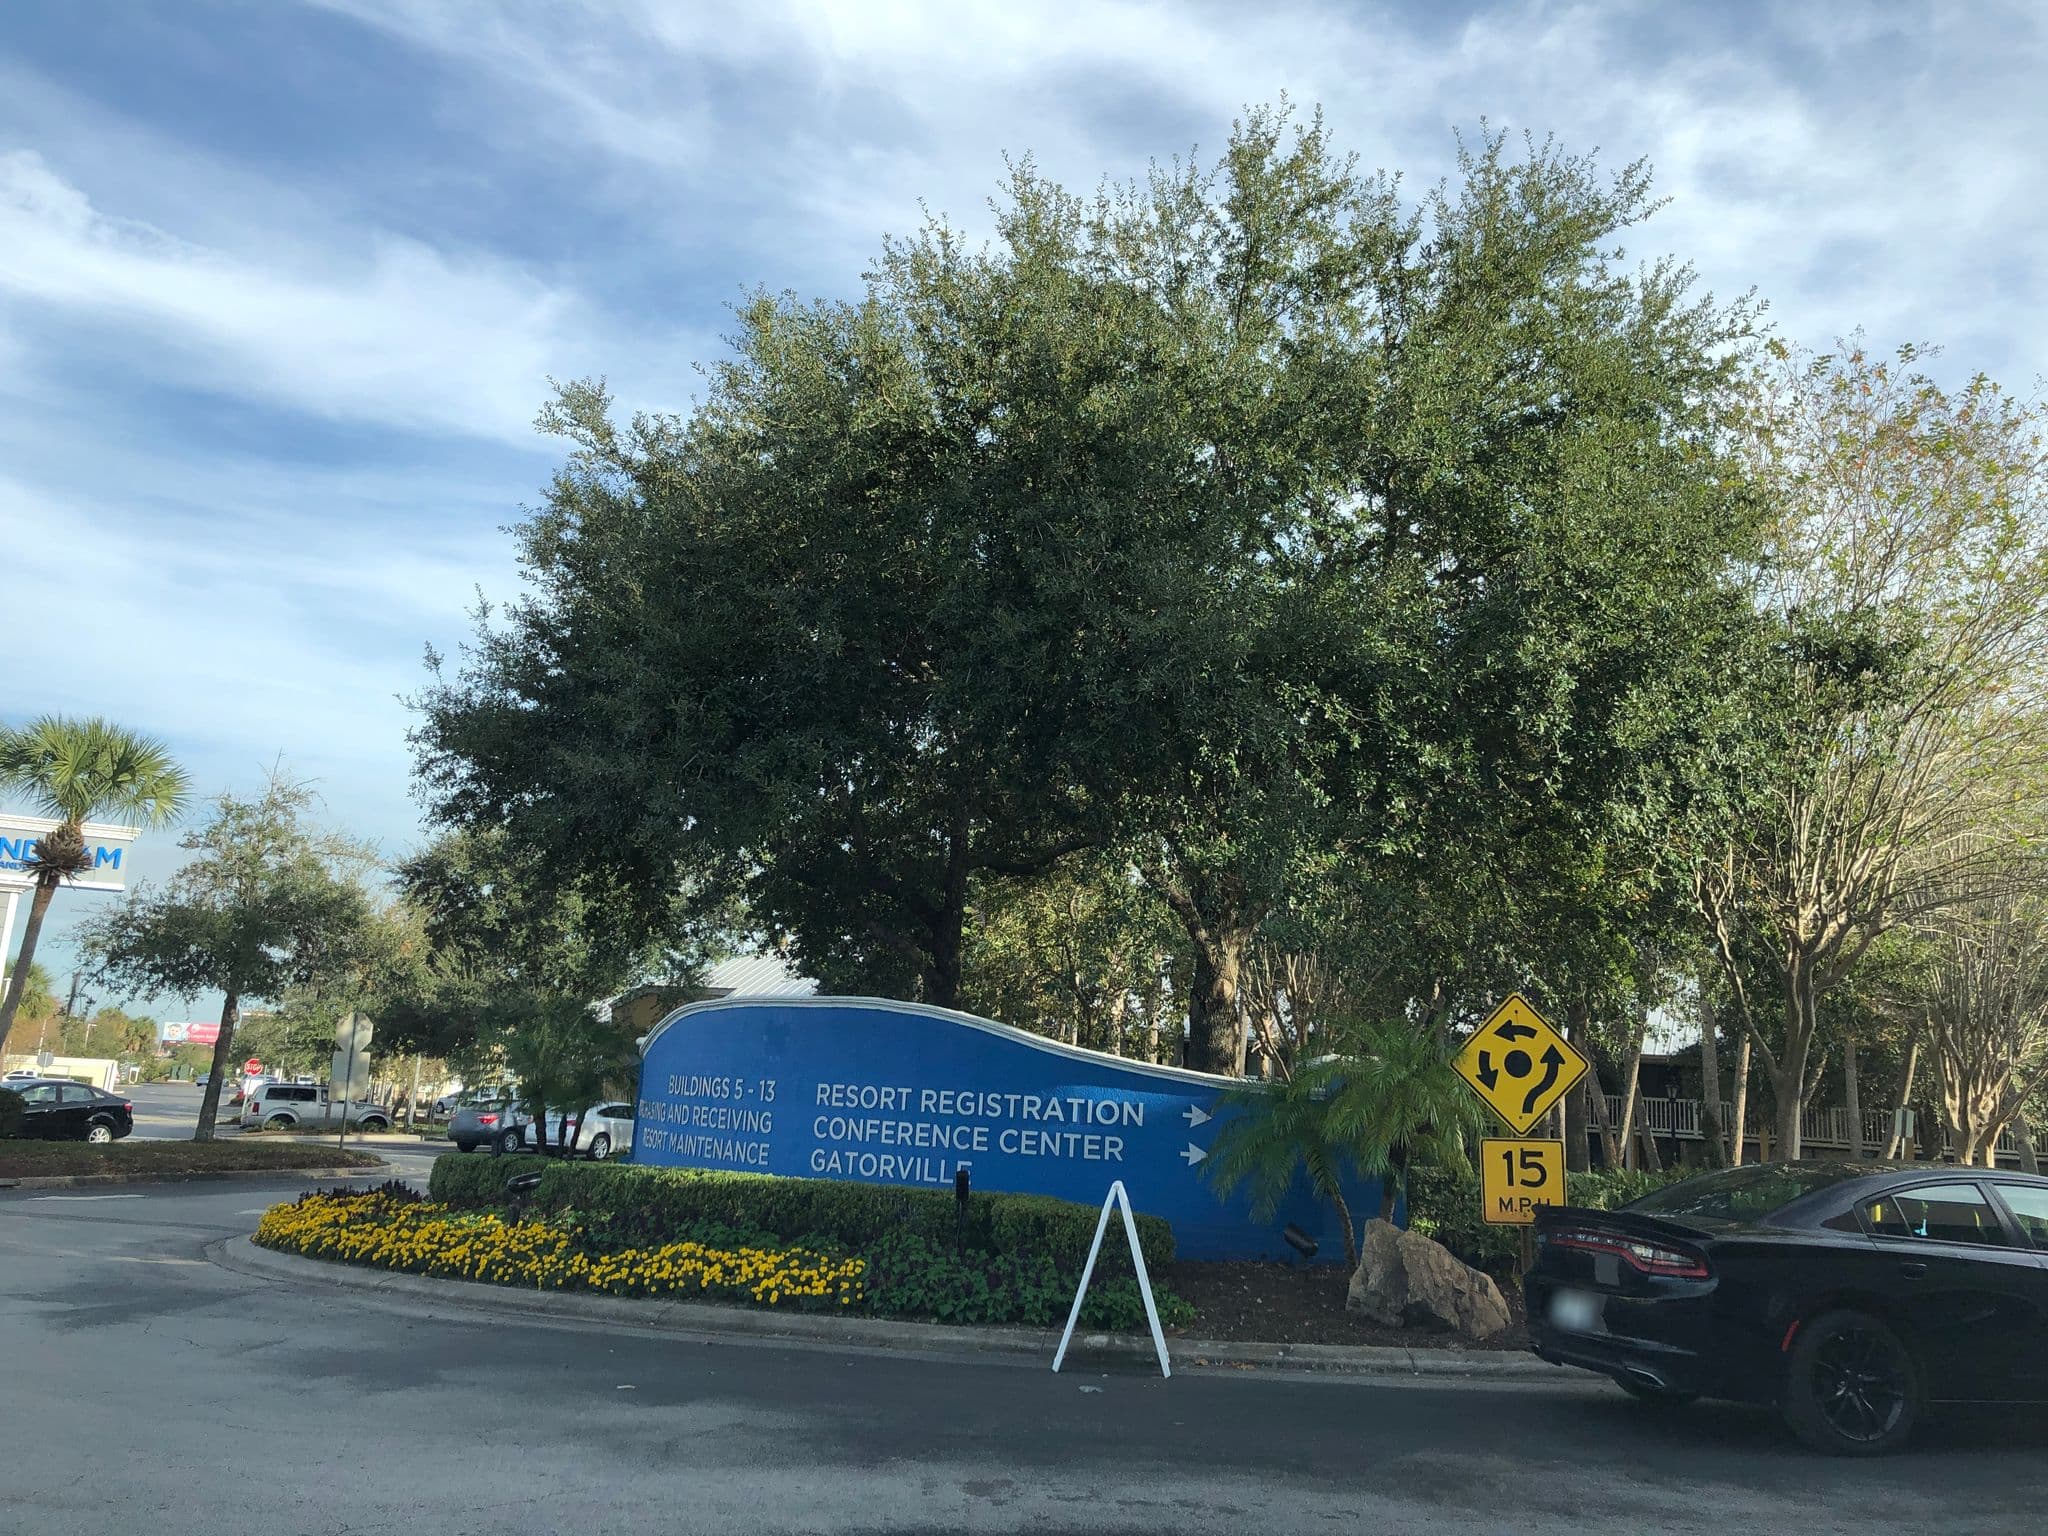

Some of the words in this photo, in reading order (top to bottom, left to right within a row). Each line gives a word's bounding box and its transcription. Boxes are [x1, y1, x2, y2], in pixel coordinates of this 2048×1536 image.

[668, 1074, 730, 1099] BUILDINGS
[734, 1078, 743, 1100] 5
[759, 1079, 776, 1102] 13
[816, 1083, 912, 1111] RESORT
[920, 1089, 1144, 1127] REGISTRATION
[667, 1103, 689, 1125] AND
[692, 1105, 772, 1134] RECEIVING
[813, 1115, 989, 1152] CONFERENCE
[999, 1129, 1124, 1161] CENTER
[643, 1127, 668, 1151] RESORT
[669, 1132, 770, 1166] MAINTENANCE
[1502, 1148, 1547, 1188] 15
